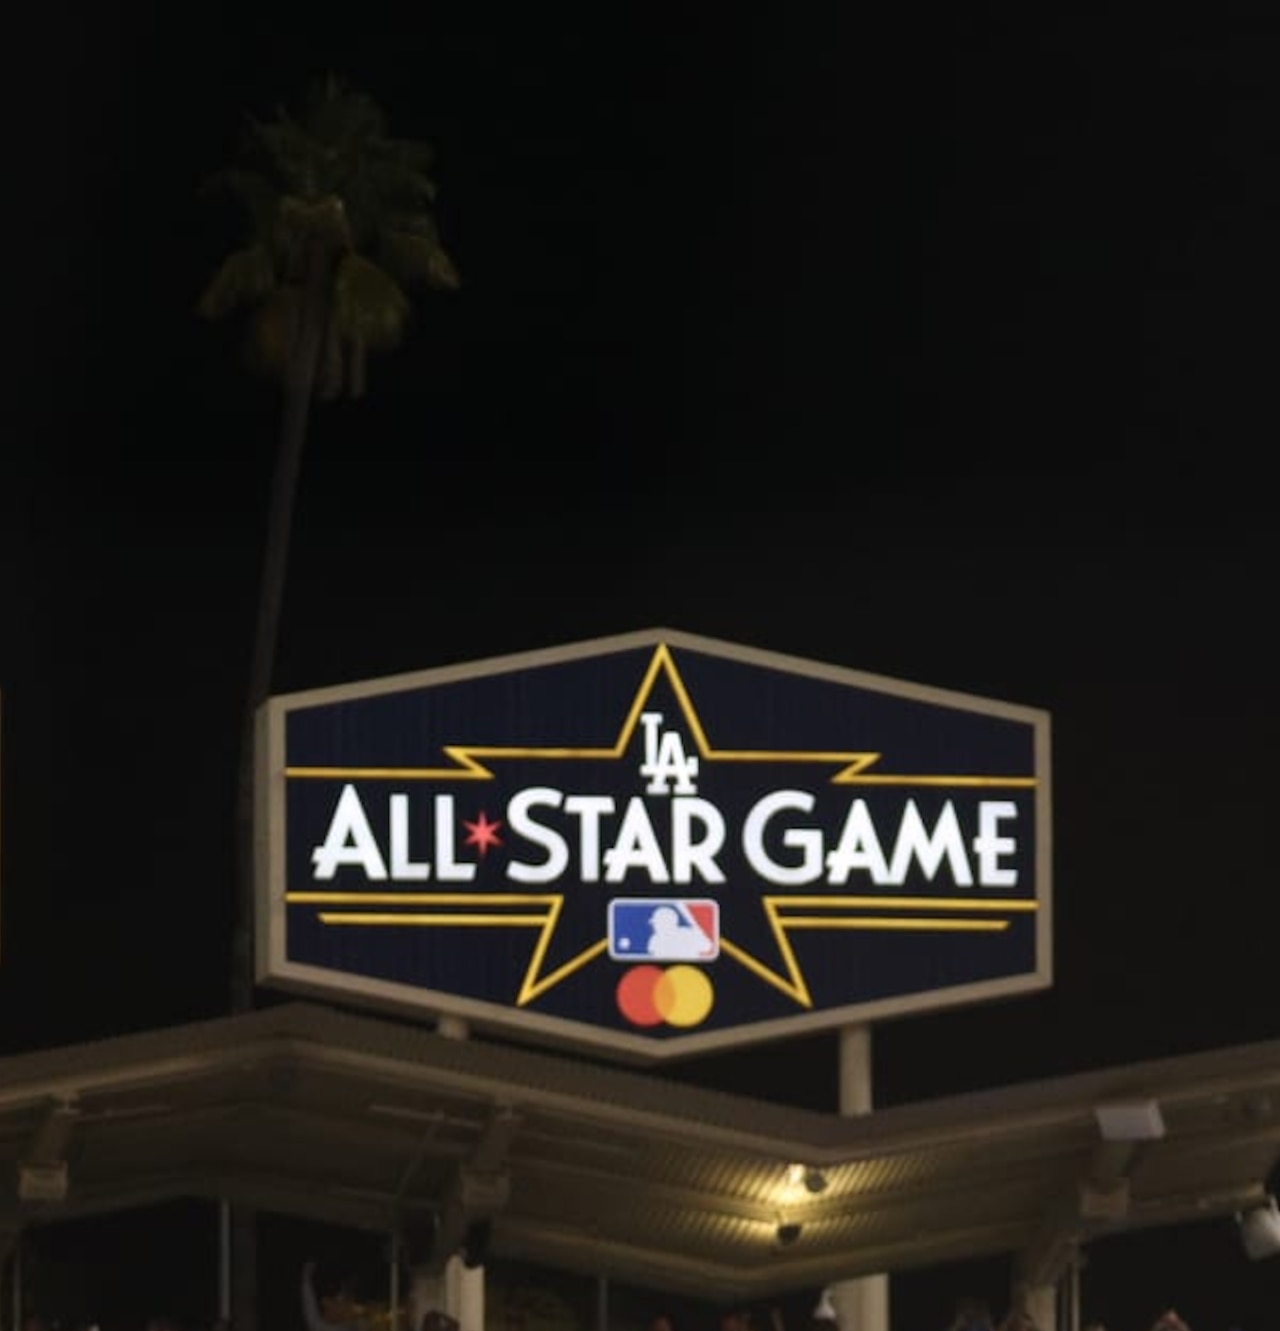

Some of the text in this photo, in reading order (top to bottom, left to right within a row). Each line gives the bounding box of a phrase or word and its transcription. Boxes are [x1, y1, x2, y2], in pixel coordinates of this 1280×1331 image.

[640, 712, 698, 795] LA
[312, 783, 1018, 887] ALL STAR GAME
